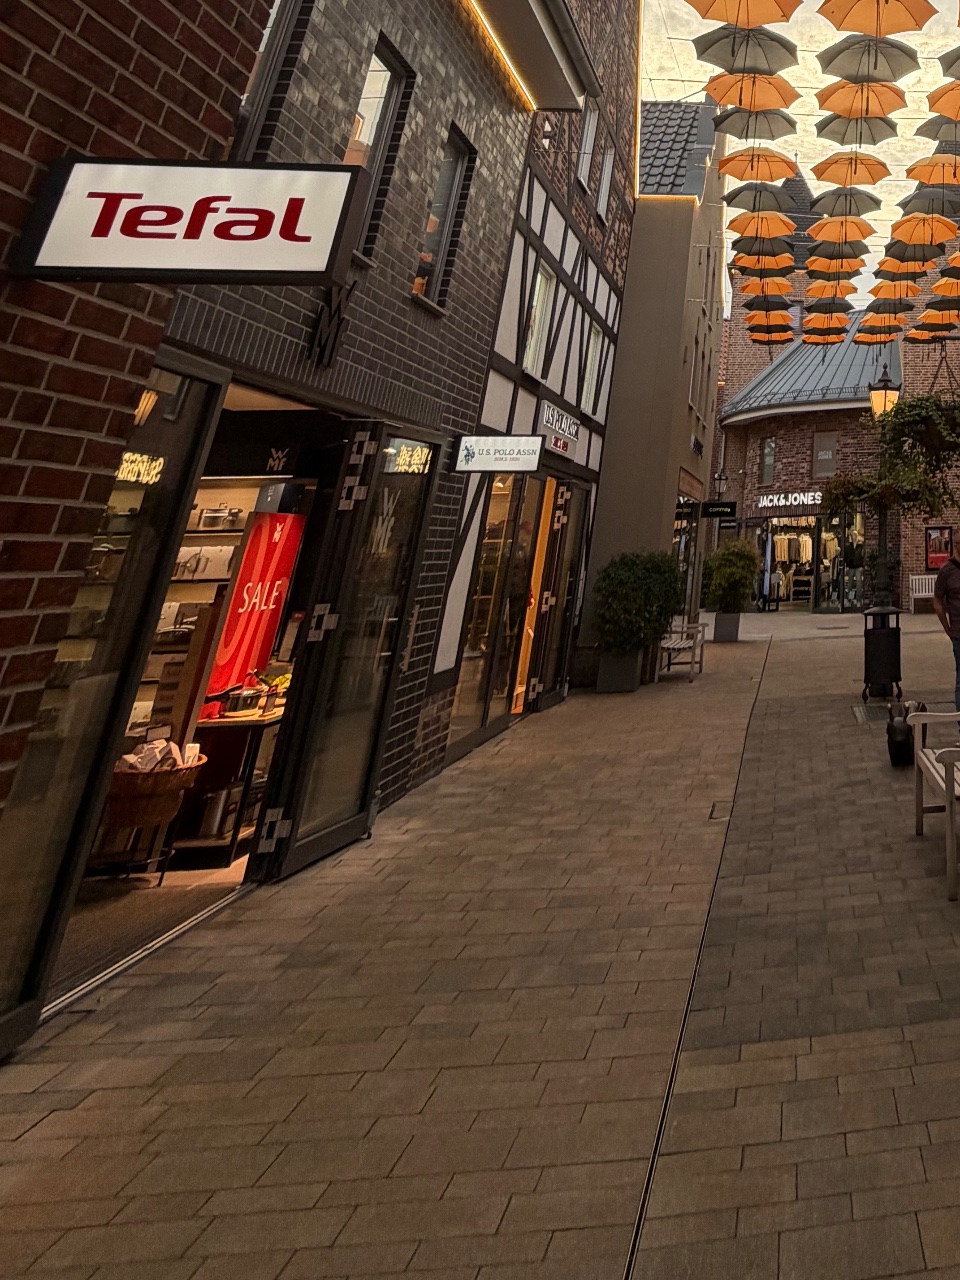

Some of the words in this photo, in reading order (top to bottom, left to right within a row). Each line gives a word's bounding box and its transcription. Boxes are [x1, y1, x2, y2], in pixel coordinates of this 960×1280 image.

[86, 191, 312, 242] Tefal
[267, 448, 290, 471] WMF
[493, 448, 515, 456] POLO
[238, 580, 282, 613] SALE
